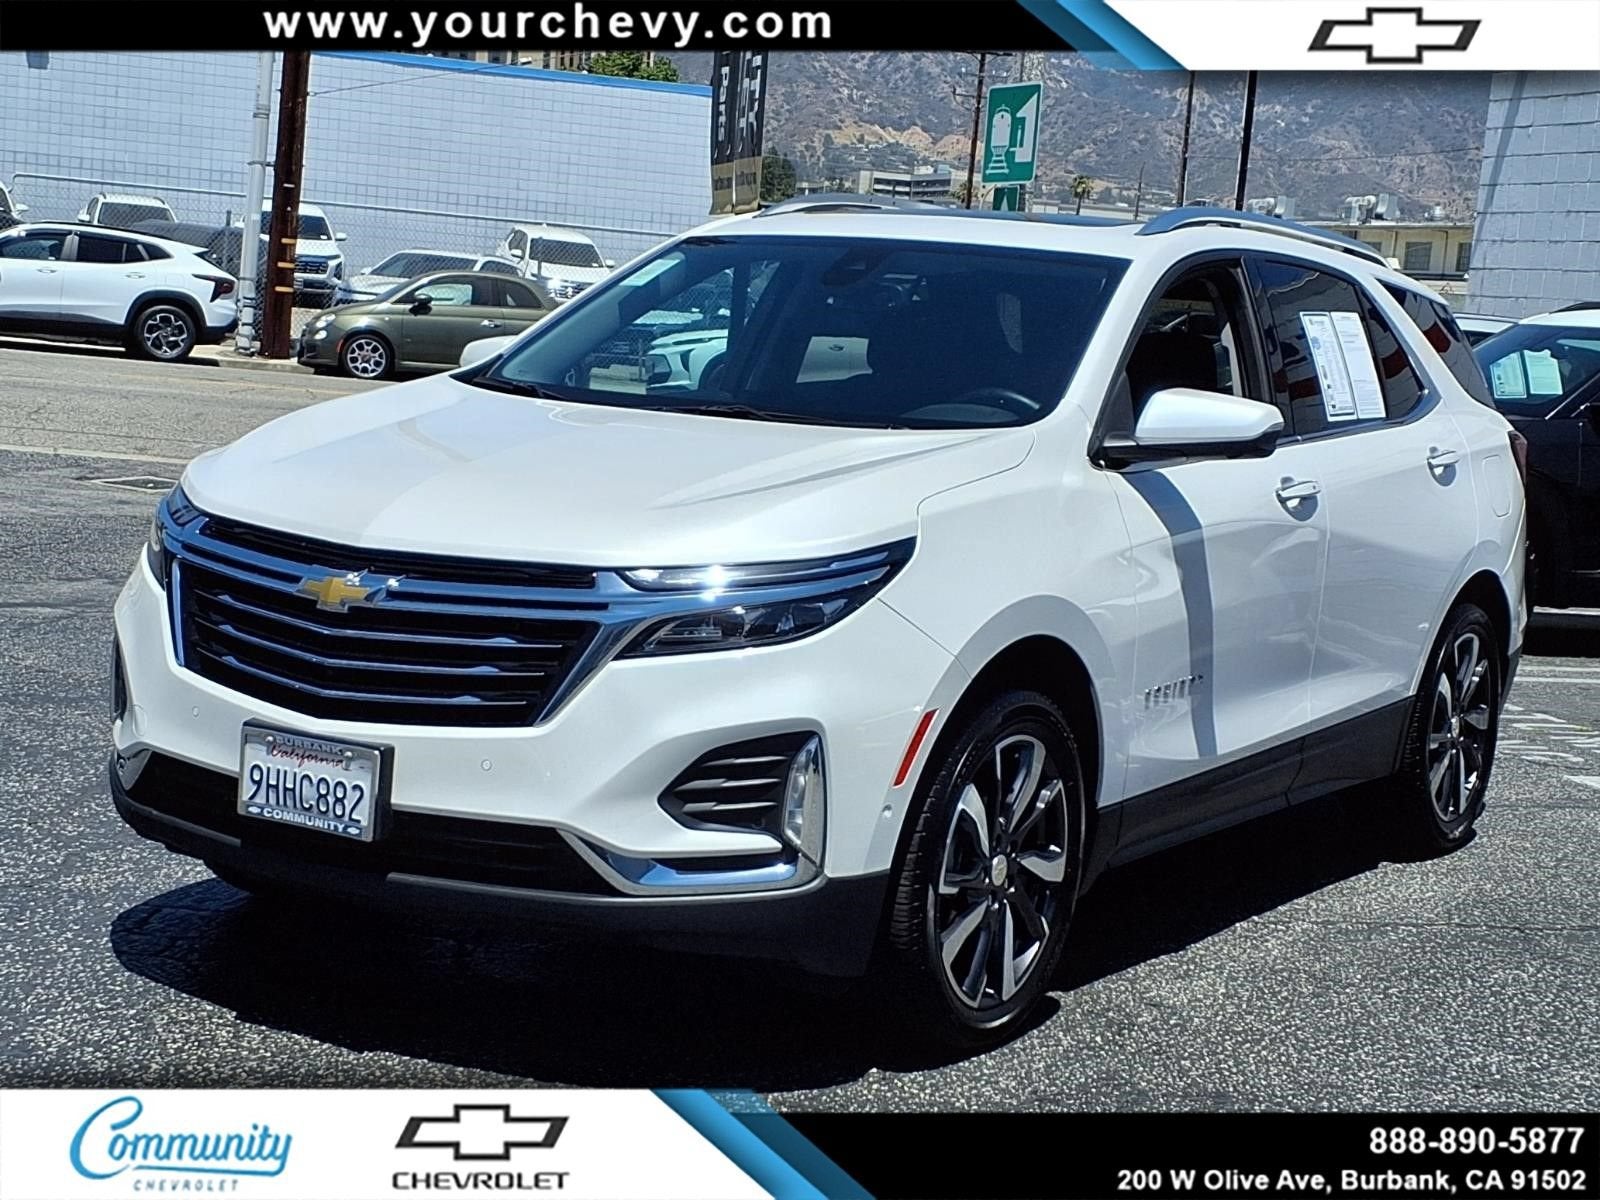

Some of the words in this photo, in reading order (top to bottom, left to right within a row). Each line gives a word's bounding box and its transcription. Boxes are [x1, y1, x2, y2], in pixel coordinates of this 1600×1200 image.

[718, 66, 730, 142] Parts
[271, 745, 345, 768] California
[275, 736, 344, 757] BURBANK
[247, 763, 364, 824] 9HHC882
[263, 807, 345, 833] COMMUNITY
